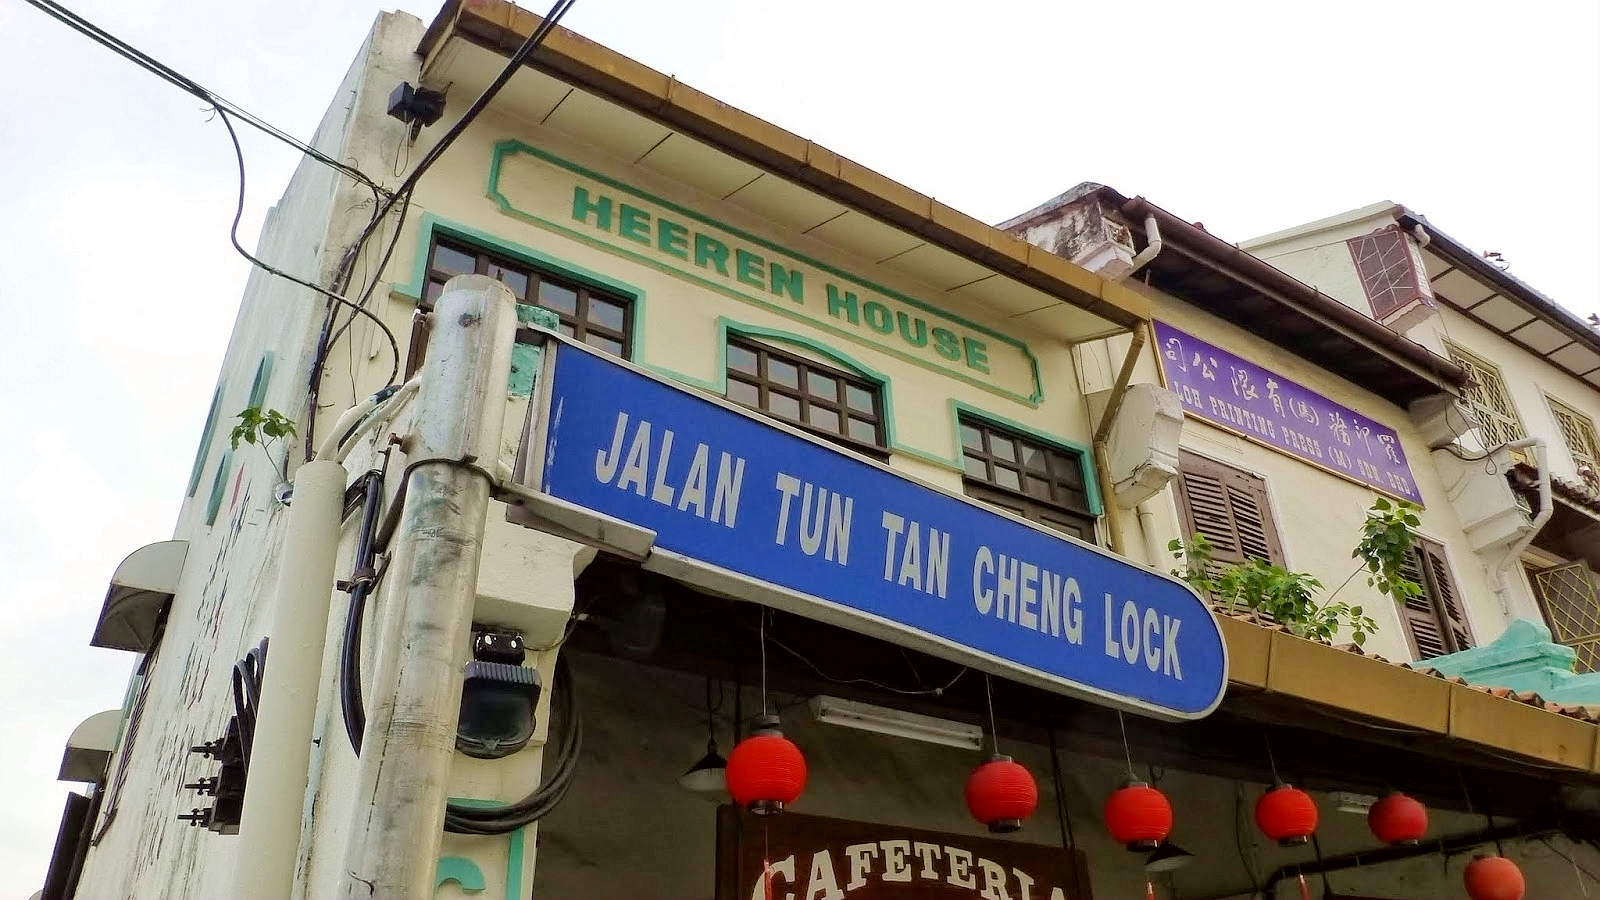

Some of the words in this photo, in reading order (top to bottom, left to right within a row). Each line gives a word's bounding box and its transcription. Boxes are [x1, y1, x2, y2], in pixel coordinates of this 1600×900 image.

[572, 186, 804, 305] HEEREN
[827, 283, 991, 374] HOUSE
[1174, 381, 1203, 409] LOH
[1209, 395, 1276, 439] PRINTING
[1281, 426, 1322, 458] PRESS
[1328, 446, 1352, 470] (M)
[1357, 458, 1384, 484] SDN.
[1387, 471, 1415, 497] BHD.
[596, 411, 745, 528] JALAN
[775, 473, 854, 567] TUN
[881, 511, 950, 599] TAN
[972, 545, 1083, 645] CHENG
[1105, 592, 1183, 681] LOCK
